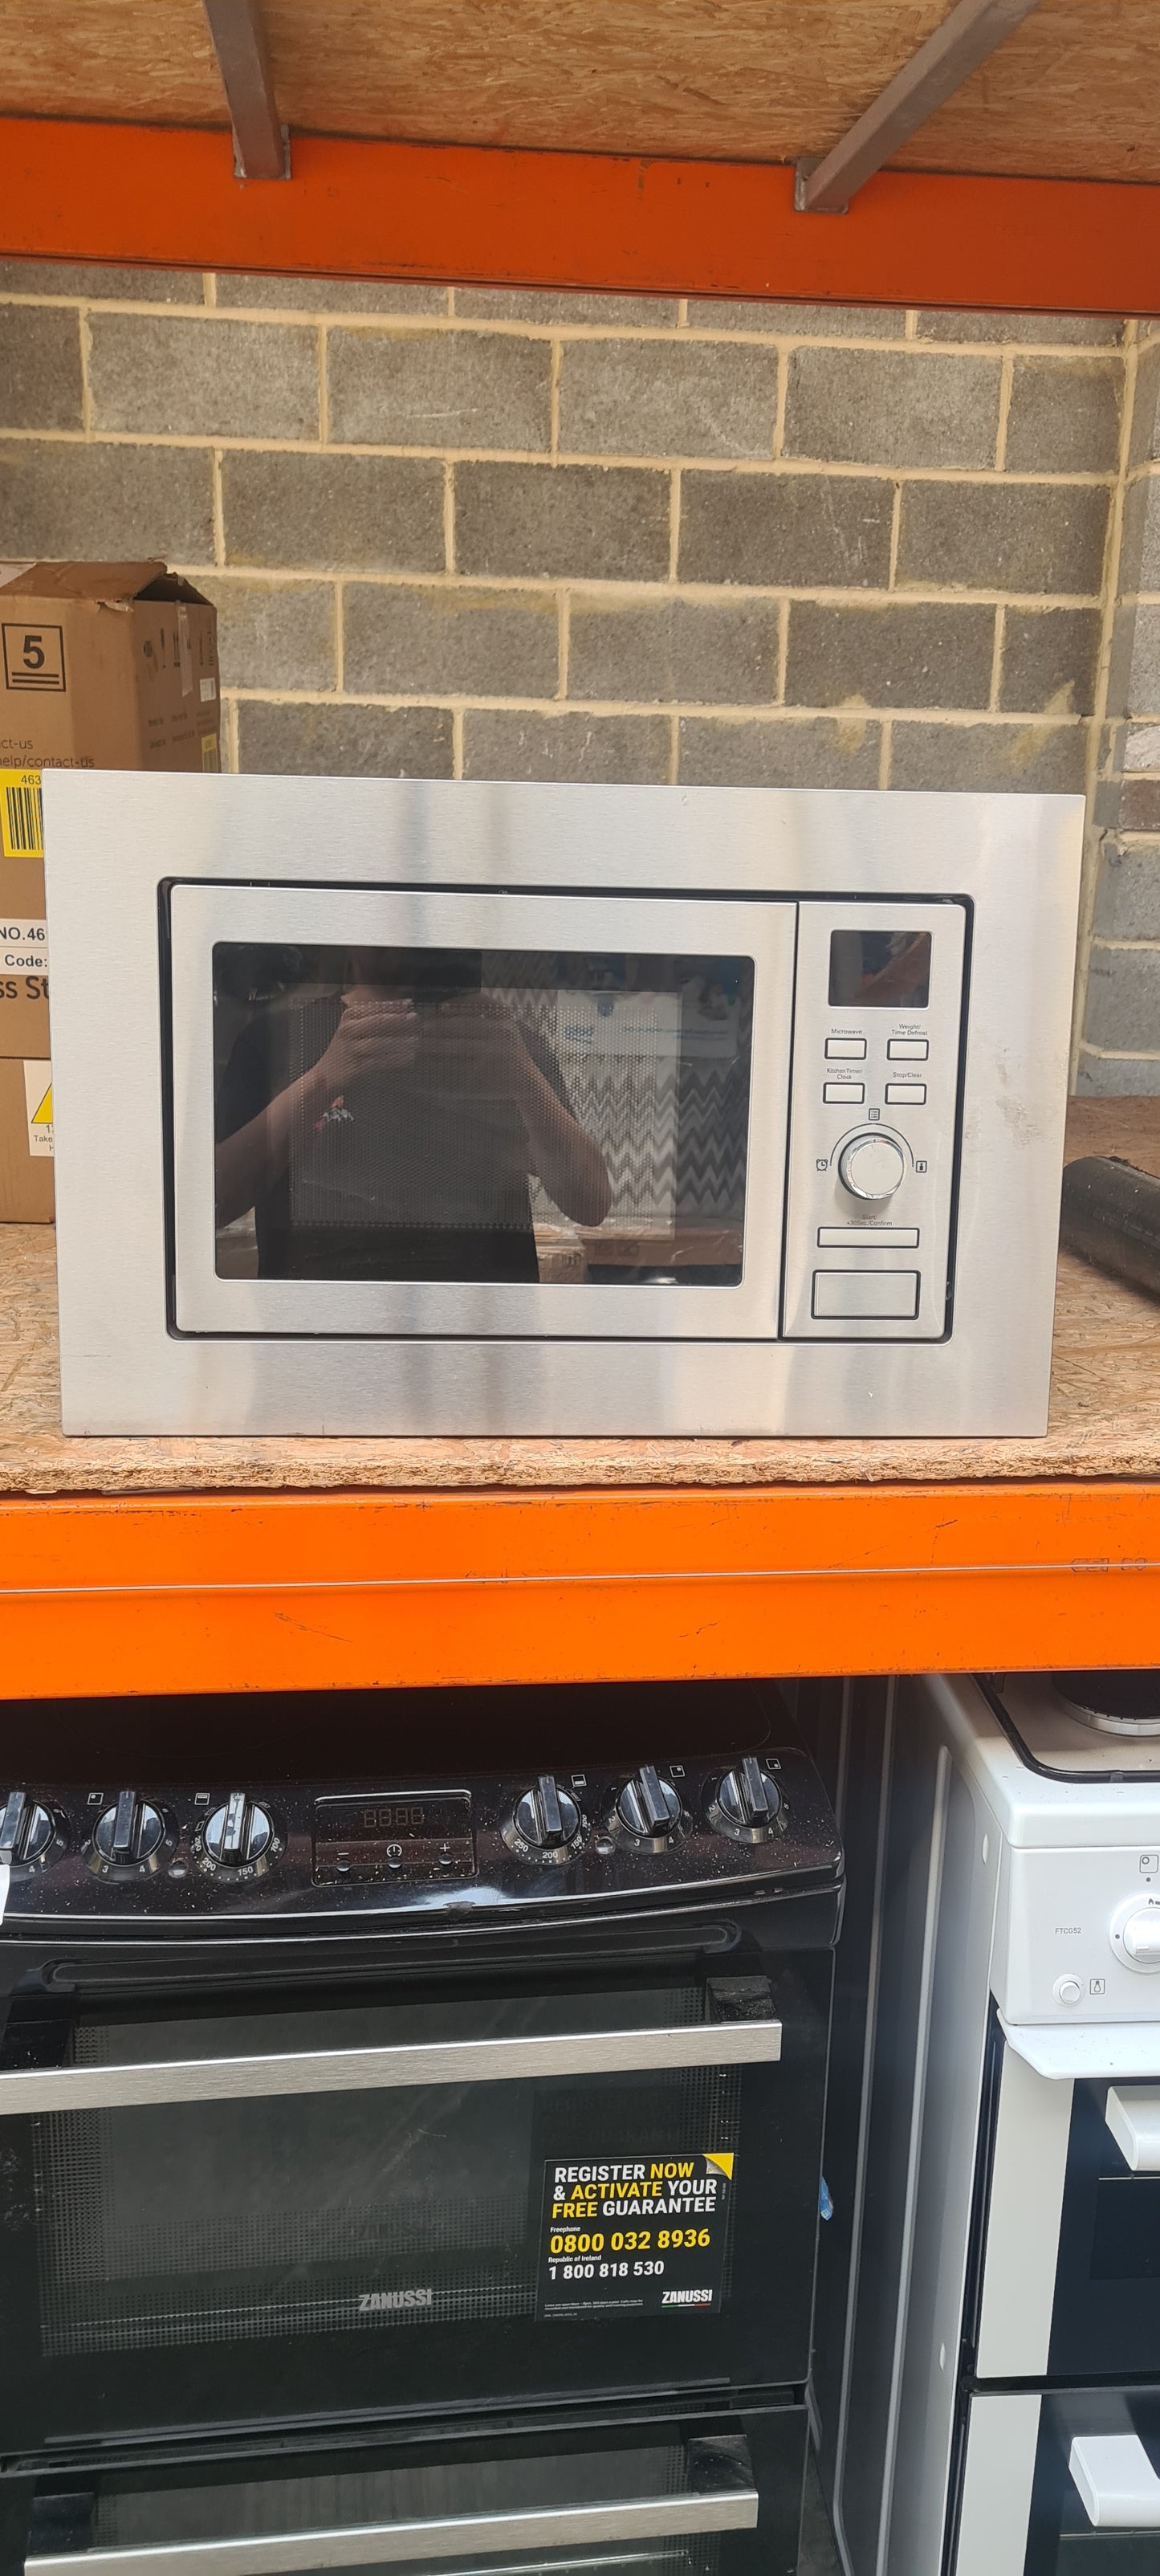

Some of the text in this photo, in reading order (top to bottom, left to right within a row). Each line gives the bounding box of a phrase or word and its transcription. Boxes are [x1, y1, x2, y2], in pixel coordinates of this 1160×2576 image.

[22, 634, 45, 669] 5
[0, 739, 34, 750] ct-us
[21, 775, 42, 785] 463
[0, 927, 48, 940] NO.46
[5, 954, 47, 968] Code:
[33, 1135, 54, 1143] Take
[767, 1827, 774, 1835] 4
[514, 1838, 529, 1853] 250
[542, 1851, 559, 1859] 200
[571, 1836, 582, 1849] 150
[633, 1838, 641, 1847] 3
[668, 1836, 674, 1844] 4
[202, 1857, 217, 1871] 200
[237, 1865, 254, 1876] 150
[270, 1837, 281, 1853] 100
[29, 1865, 35, 1873] 4
[102, 1865, 109, 1873] 3
[554, 2162, 694, 2183] REGISTER NOW
[553, 2186, 566, 2201] &
[571, 2181, 663, 2200] ACTIVATE
[668, 2179, 718, 2196] YOUR
[552, 2196, 716, 2219] FREE GUARANTEE
[550, 2226, 581, 2234] Freephone
[551, 2228, 710, 2253] 0800 032 8936
[548, 2260, 665, 2280] 1 800 818 530
[359, 2289, 432, 2311] ZANUSSI
[661, 2289, 713, 2304] ZANUSSI
